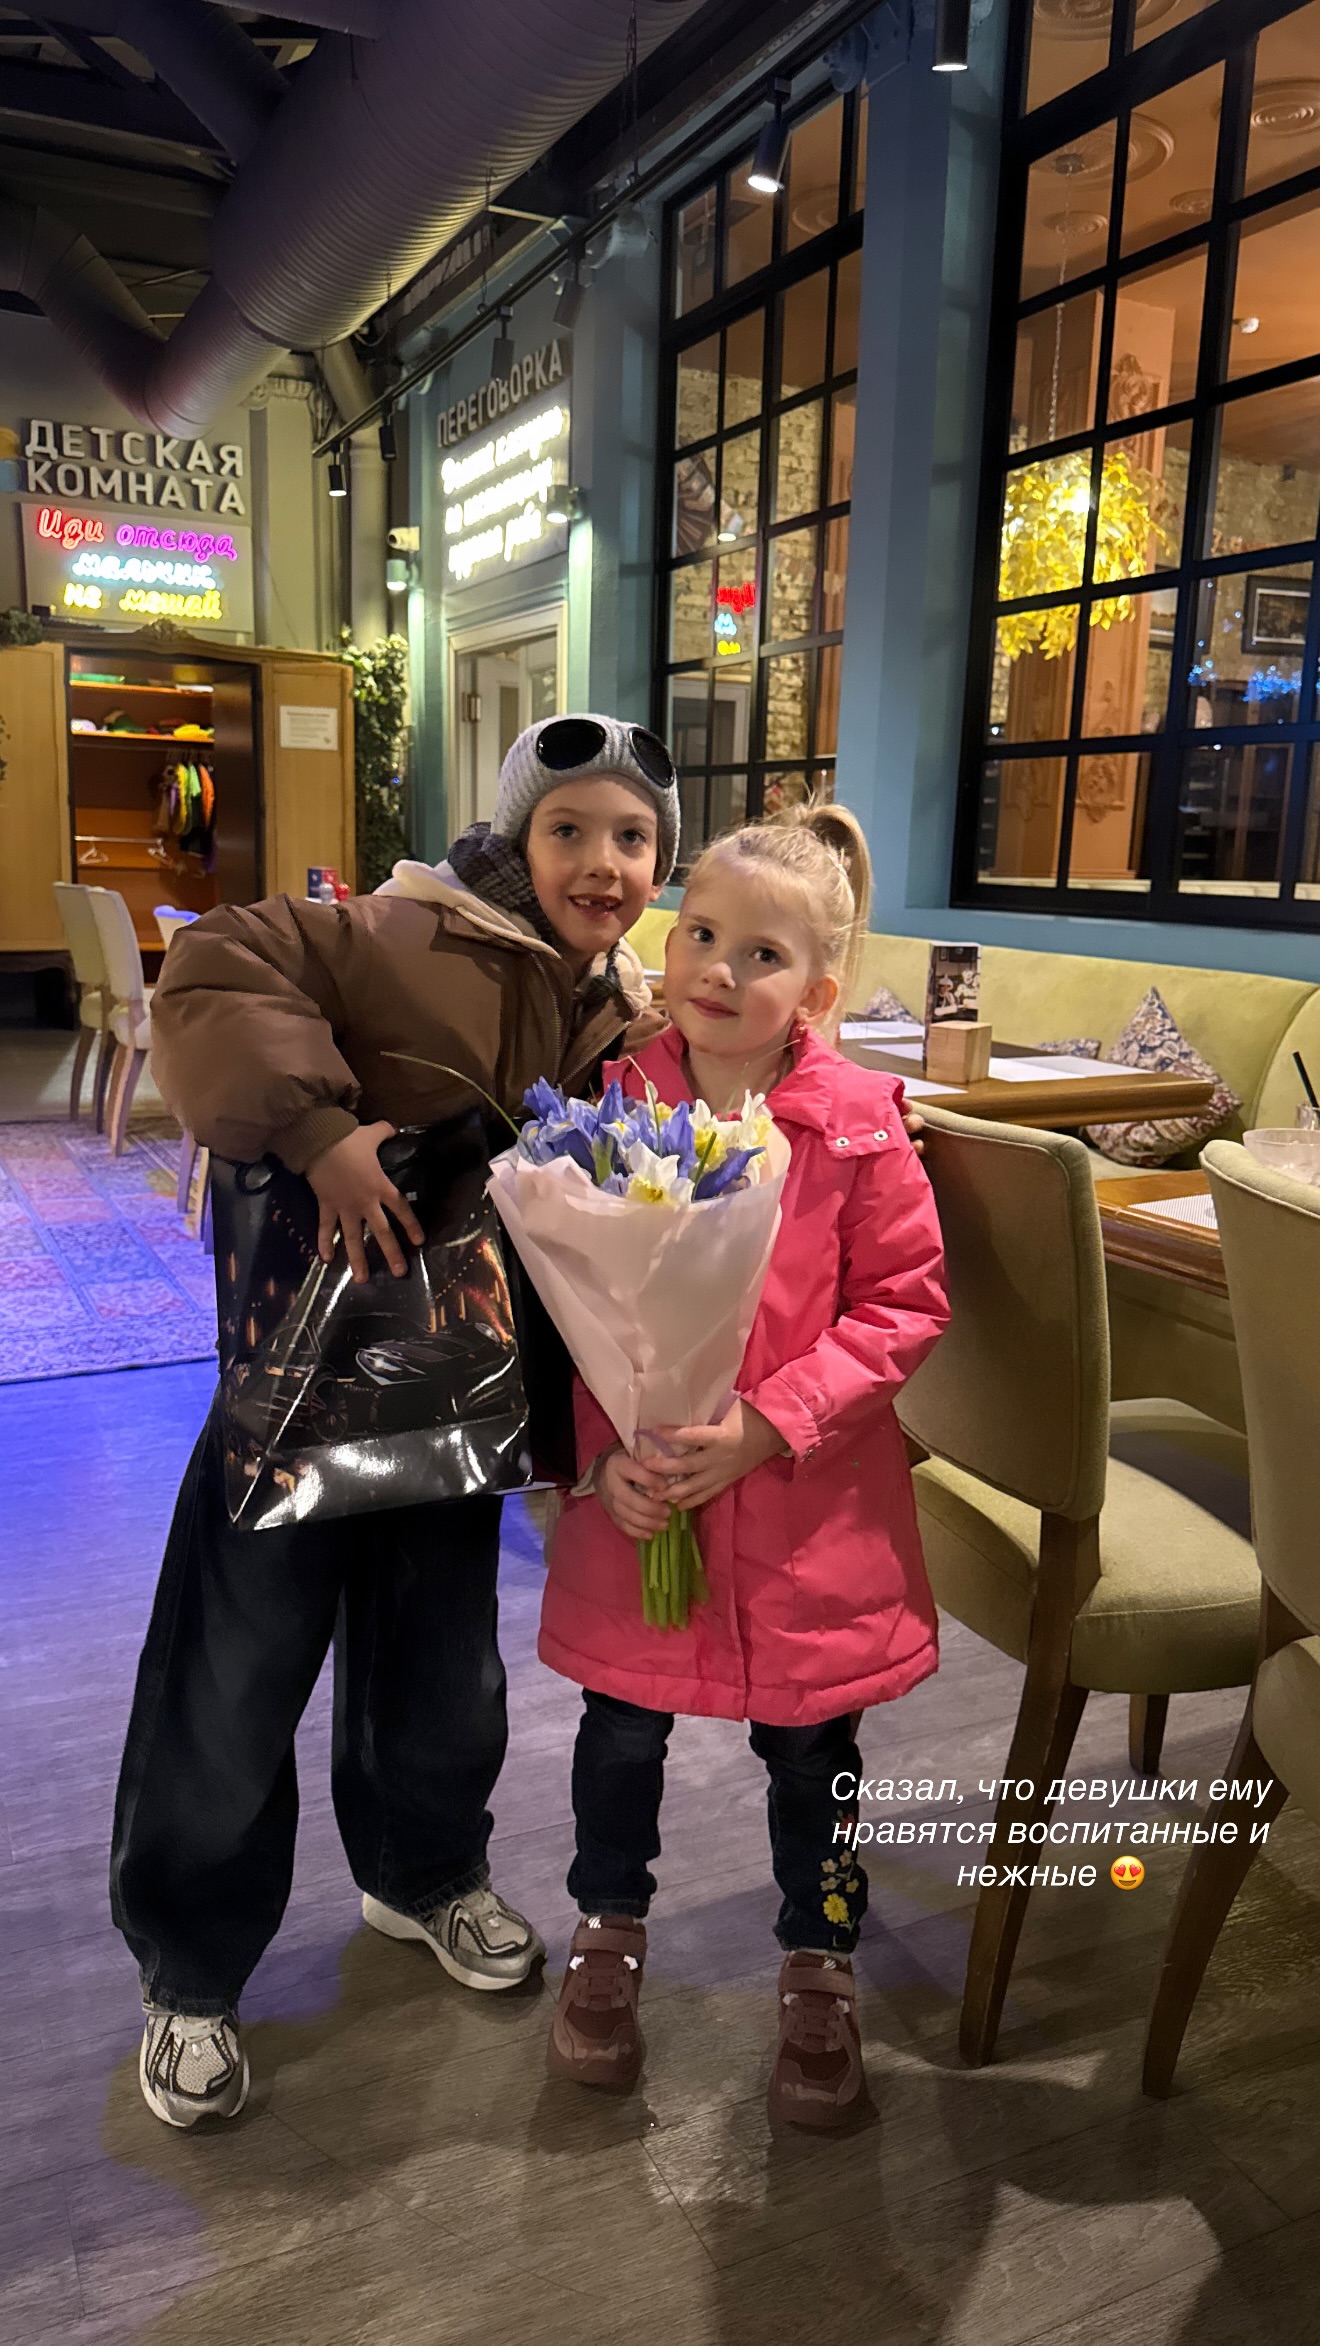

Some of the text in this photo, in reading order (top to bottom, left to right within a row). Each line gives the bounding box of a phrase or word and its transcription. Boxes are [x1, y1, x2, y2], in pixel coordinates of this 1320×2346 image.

[437, 338, 563, 448] ПЕРЕГОВОРКА
[24, 418, 244, 478] ДЕТСКАЯ
[26, 458, 246, 516] КОМНАТА
[38, 507, 238, 563] Иди отсюда
